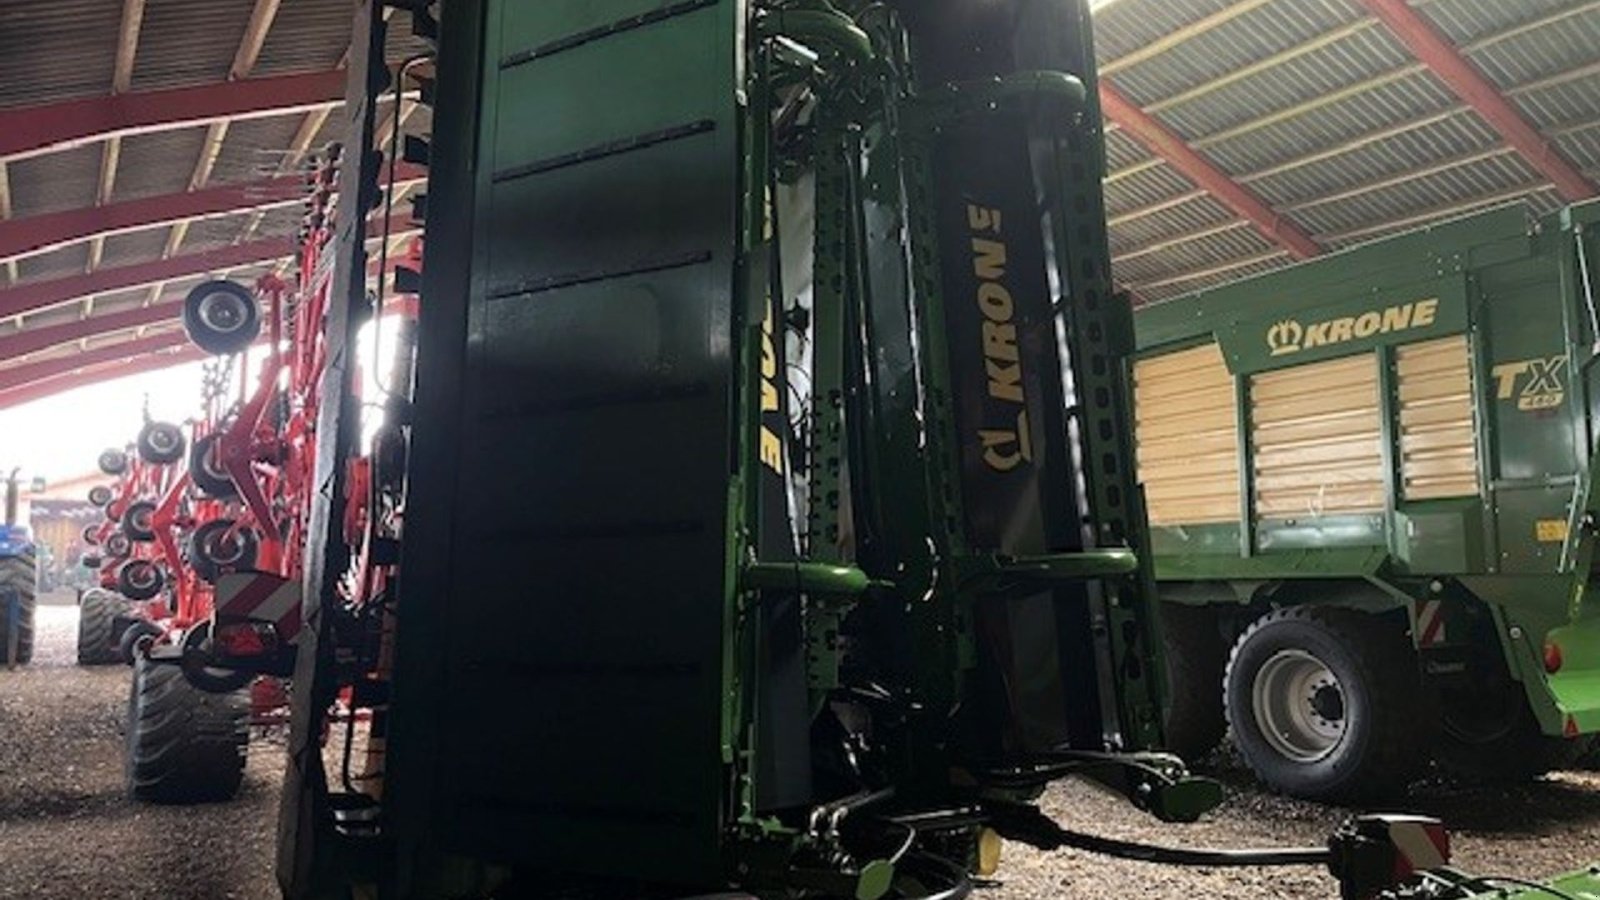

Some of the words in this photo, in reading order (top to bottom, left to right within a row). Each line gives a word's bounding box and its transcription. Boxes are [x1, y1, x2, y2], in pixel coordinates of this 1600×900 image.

[967, 204, 1024, 402] KRONE
[1303, 298, 1439, 349] KRONE
[1491, 355, 1567, 399] TX
